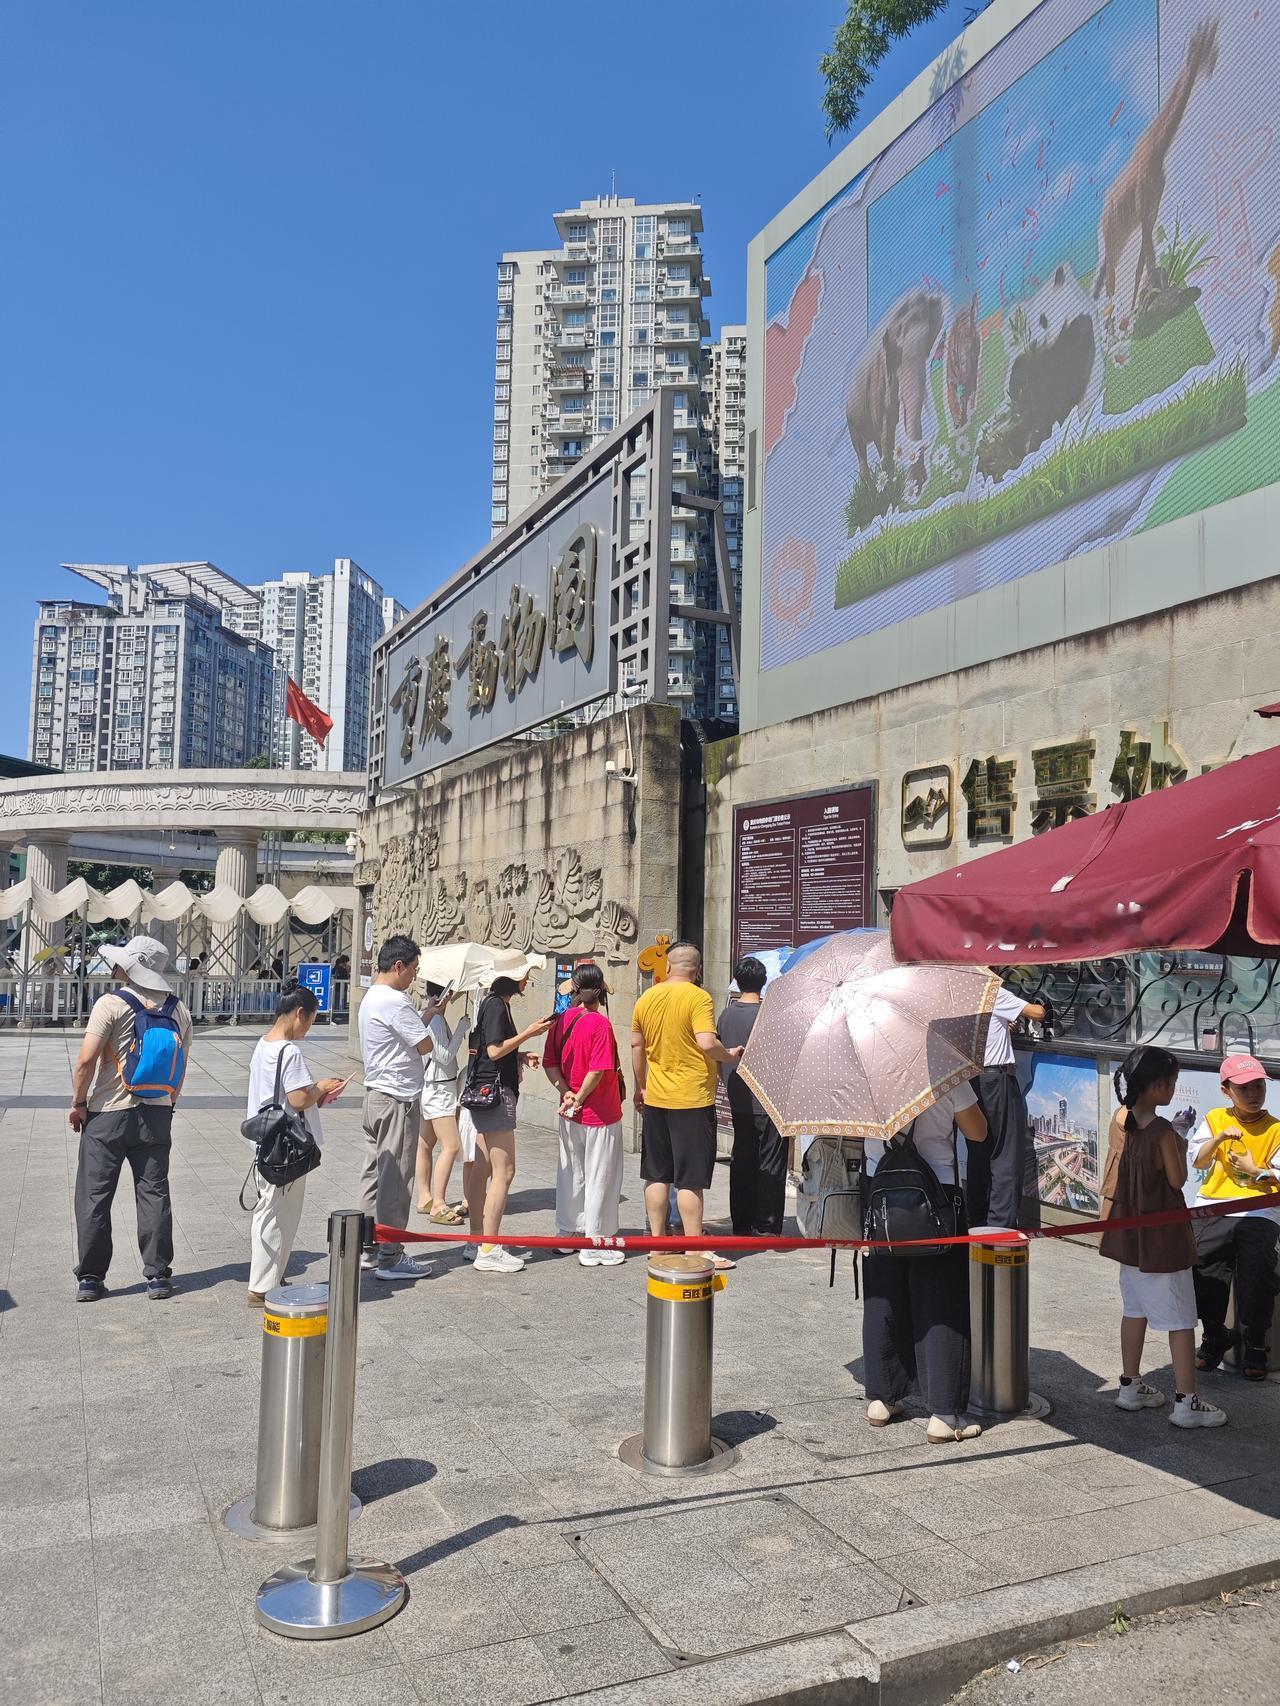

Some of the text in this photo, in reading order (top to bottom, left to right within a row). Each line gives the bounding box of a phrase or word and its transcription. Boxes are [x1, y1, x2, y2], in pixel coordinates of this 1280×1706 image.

[960, 722, 1229, 841] 售票处
[264, 1319, 280, 1332] 智能
